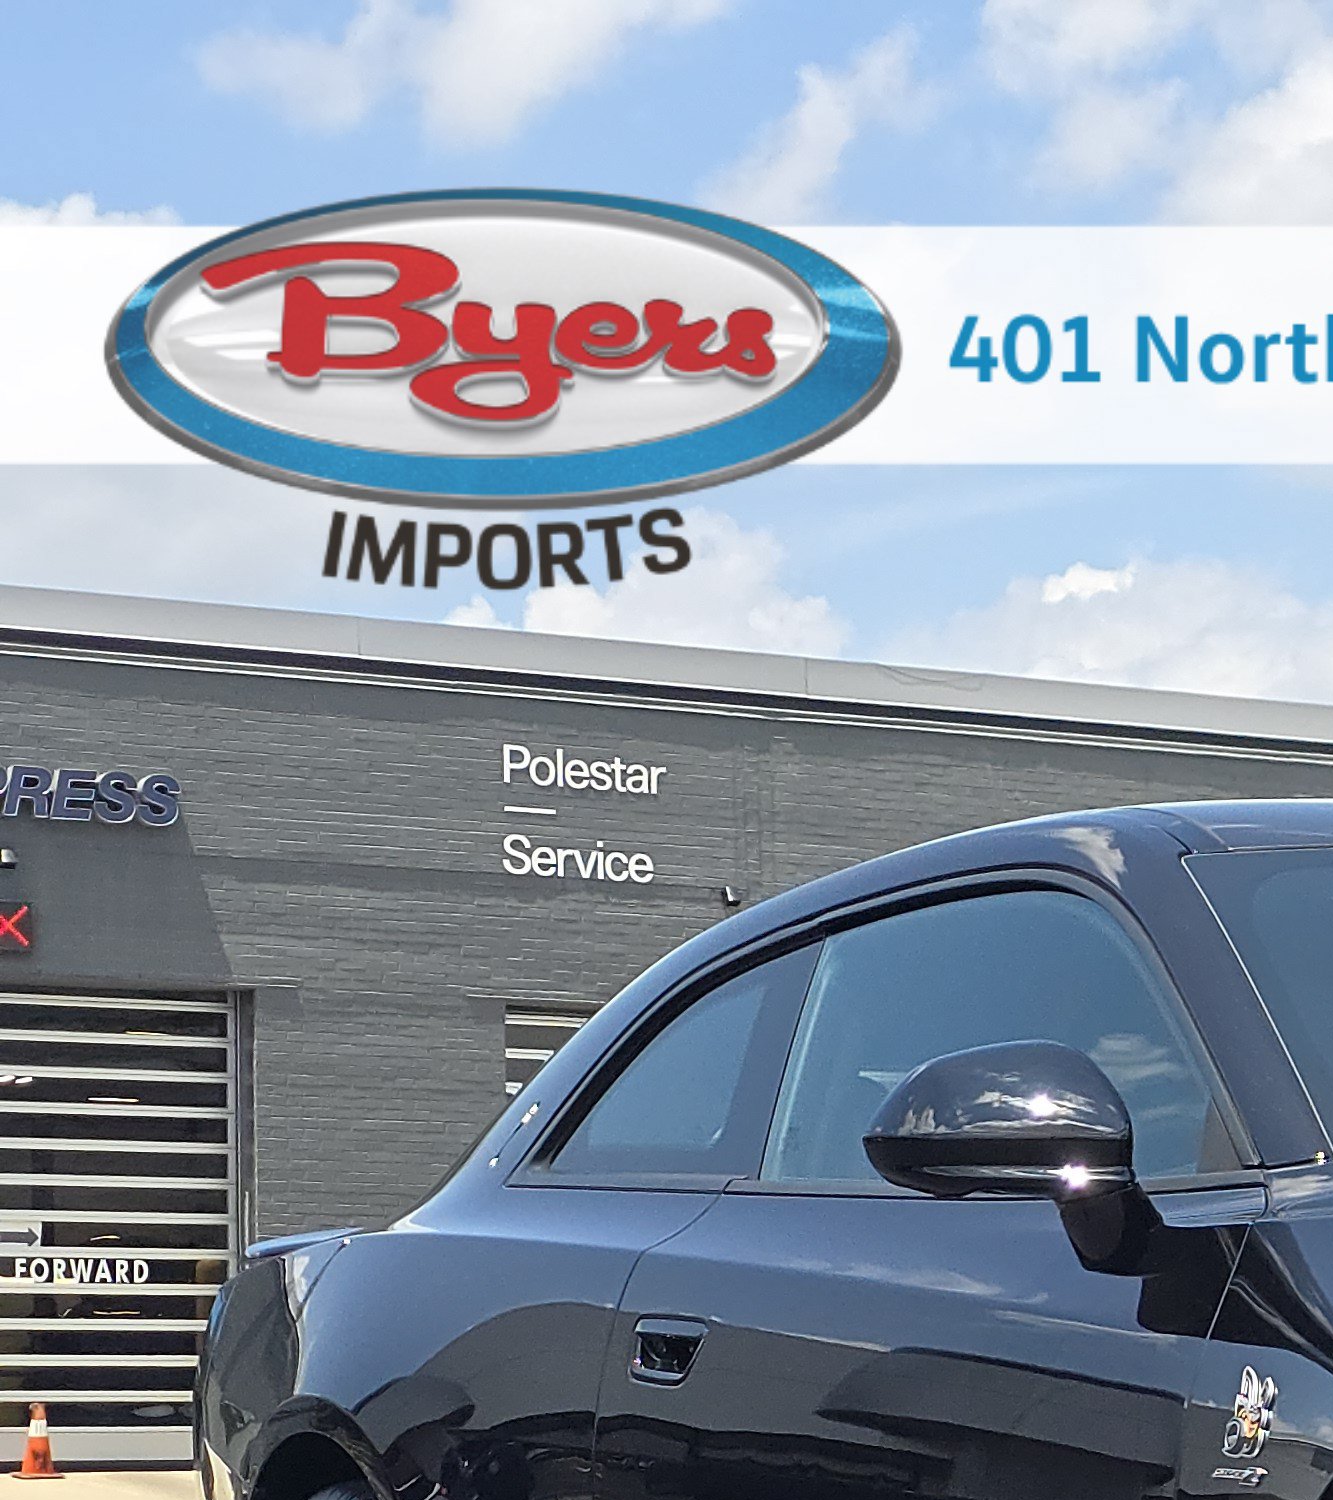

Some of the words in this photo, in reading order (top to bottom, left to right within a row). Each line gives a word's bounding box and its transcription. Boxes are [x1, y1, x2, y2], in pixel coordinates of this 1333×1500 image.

[503, 743, 667, 795] Polestar
[0, 764, 182, 828] RESS
[502, 833, 655, 883] Service
[14, 1257, 150, 1284] FORWARD
